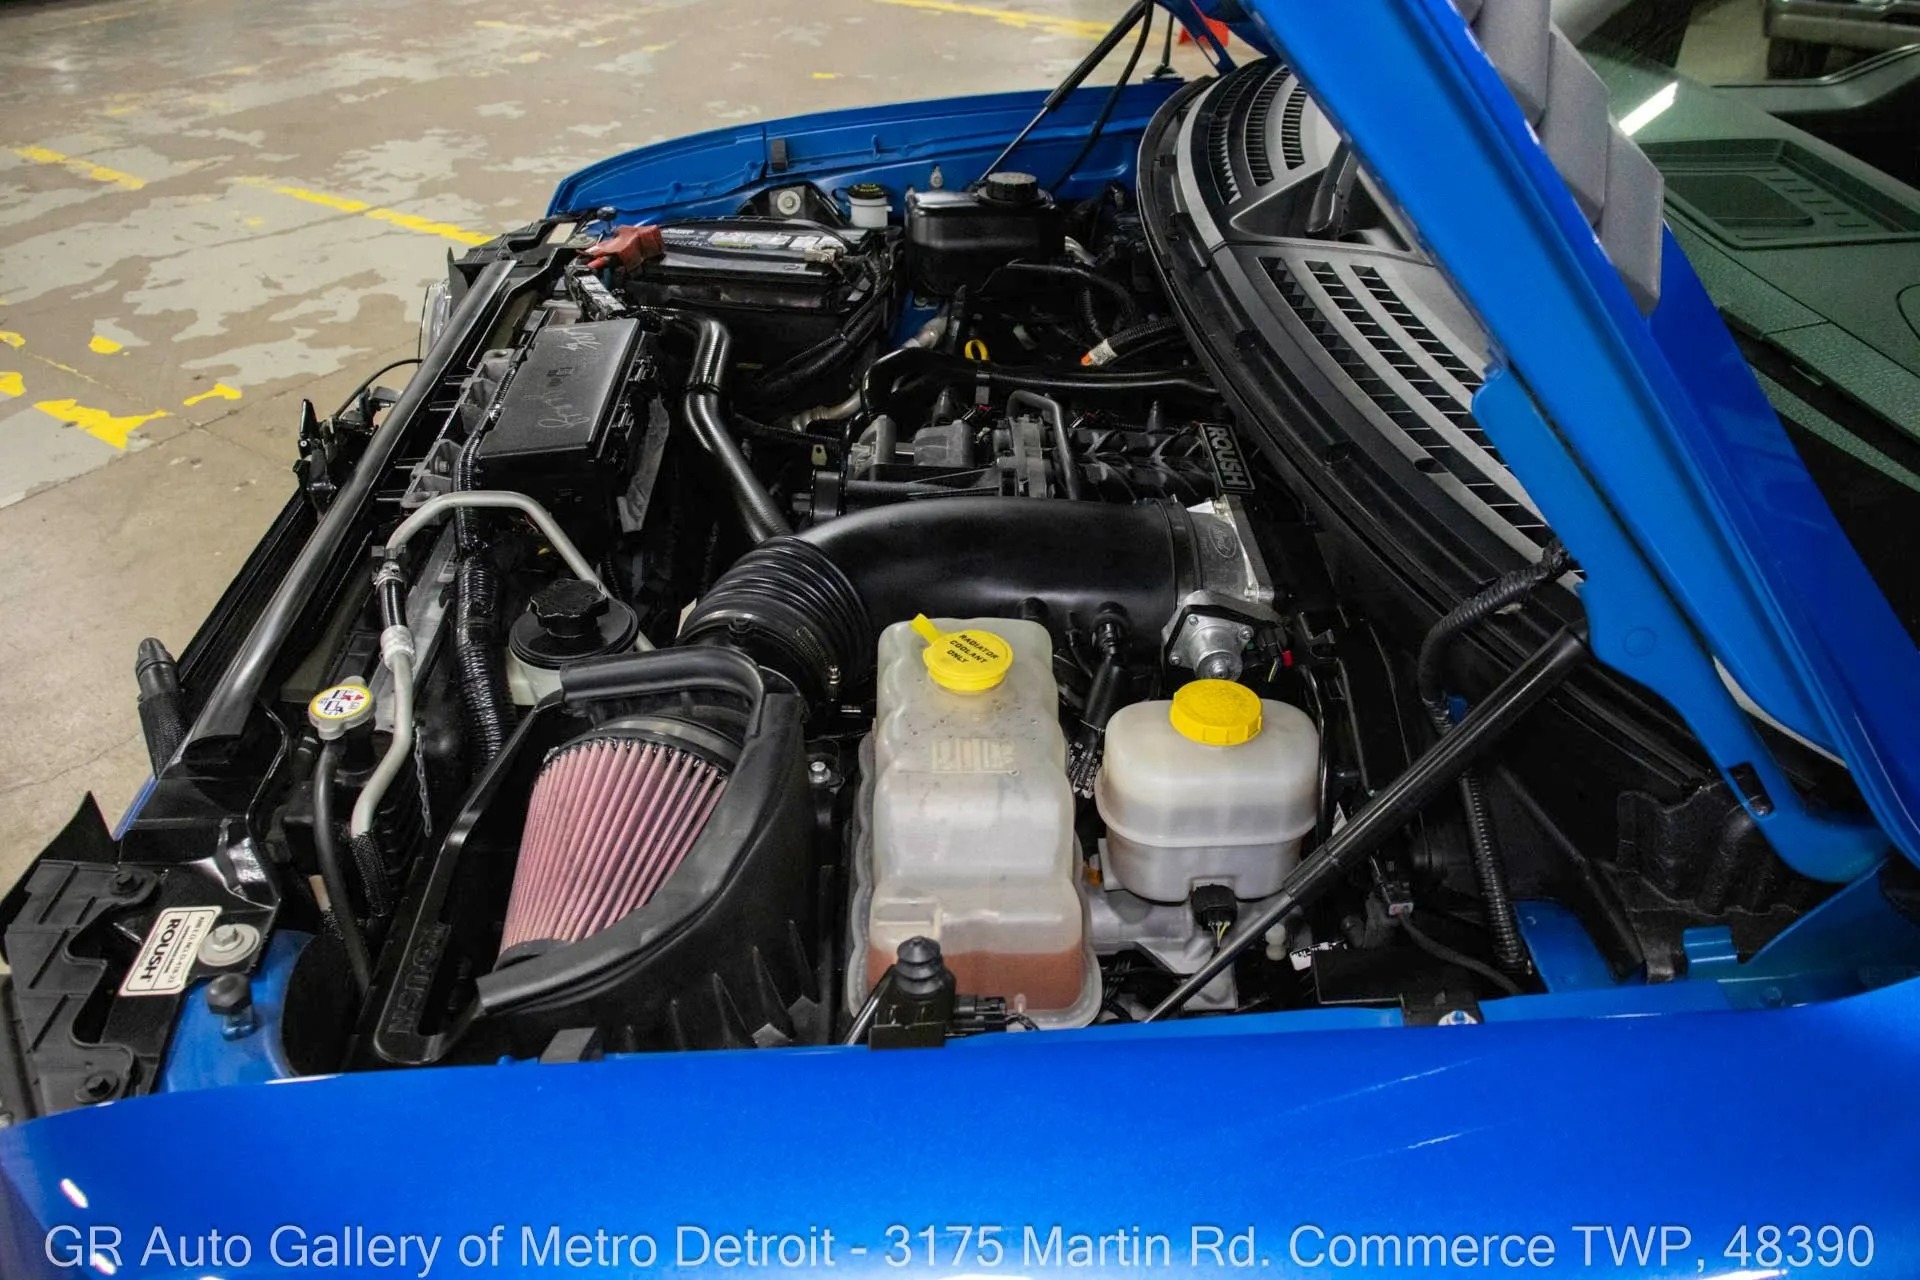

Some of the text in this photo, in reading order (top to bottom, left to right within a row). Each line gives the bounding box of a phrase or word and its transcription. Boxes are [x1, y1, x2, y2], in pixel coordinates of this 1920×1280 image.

[1207, 427, 1248, 486] ROUSH
[946, 649, 969, 664] ONLY
[949, 640, 988, 664] COOLANT
[959, 634, 999, 660] RADIATOR
[140, 918, 182, 980] ROUSH
